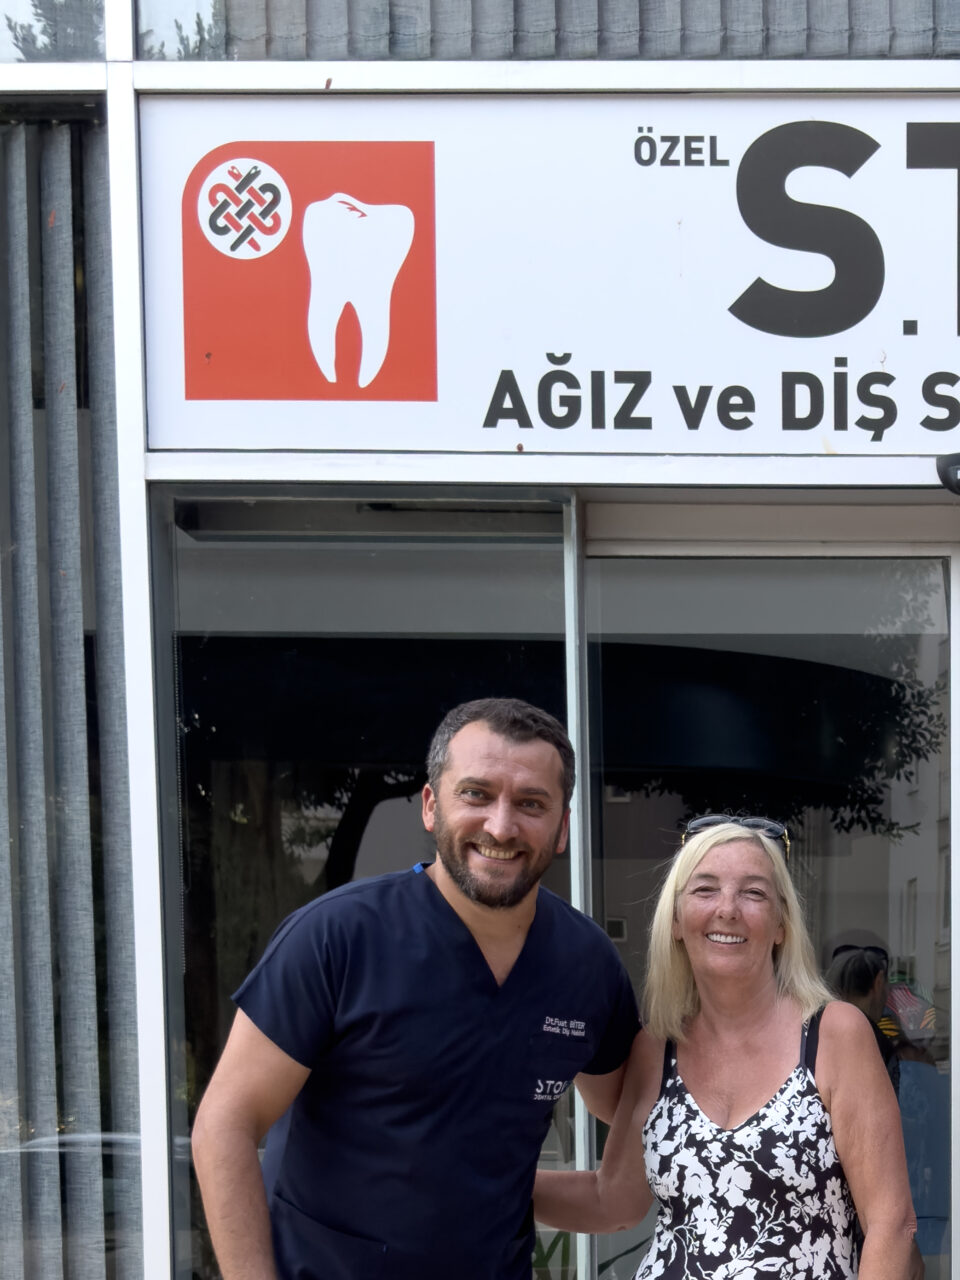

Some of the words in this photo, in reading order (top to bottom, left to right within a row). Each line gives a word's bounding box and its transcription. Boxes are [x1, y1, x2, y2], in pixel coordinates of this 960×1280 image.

[634, 126, 730, 167] ÖZEL
[482, 352, 652, 430] AĞIZ
[673, 385, 756, 431] ve
[782, 356, 898, 442] DİŞ
